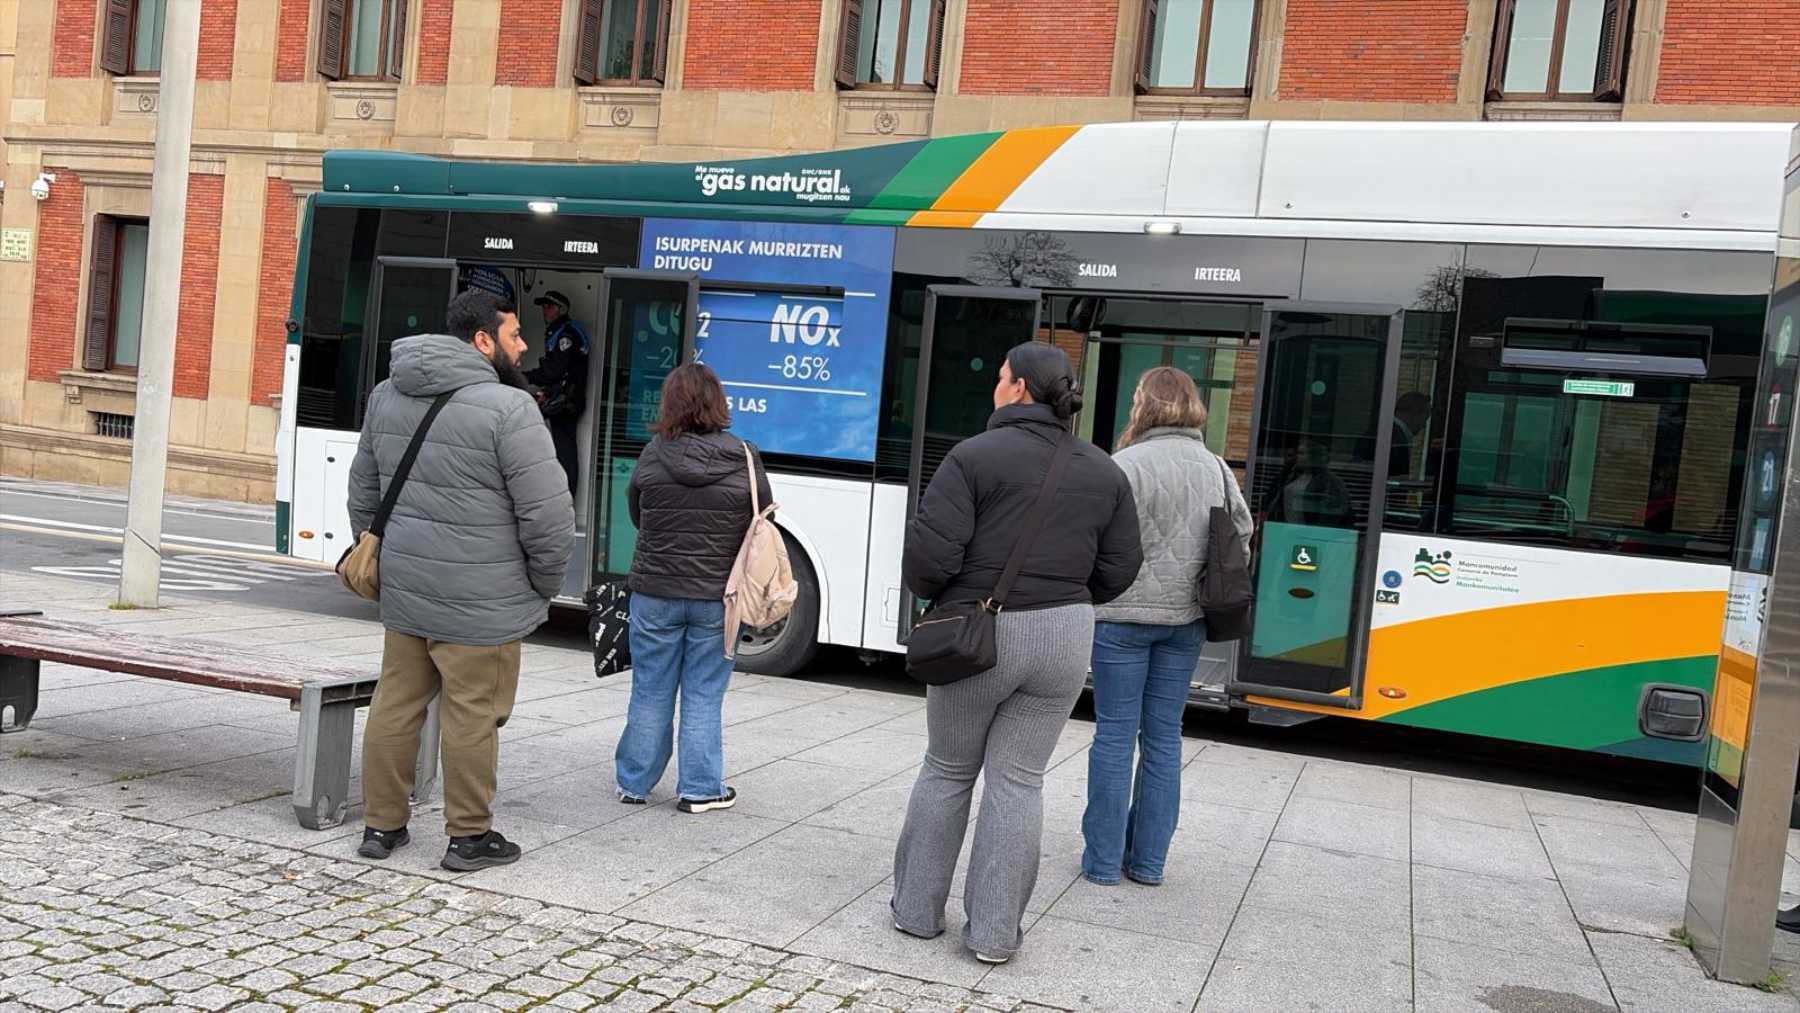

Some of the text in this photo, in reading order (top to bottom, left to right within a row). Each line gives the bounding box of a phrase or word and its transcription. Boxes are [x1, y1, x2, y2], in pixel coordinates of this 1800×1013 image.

[695, 165, 707, 173] Me
[702, 173, 746, 196] gas
[751, 169, 841, 194] natural
[796, 193, 833, 202] mugitzen
[484, 237, 599, 254] SALIDA IRTEERA
[655, 236, 843, 259] ISURPENAK MURRIZTEN
[653, 255, 713, 271] DITUGU
[1078, 263, 1241, 282] SALIDA IRTEERA
[769, 303, 841, 347] NOx
[768, 355, 831, 382] -85%
[738, 397, 767, 413] LAS
